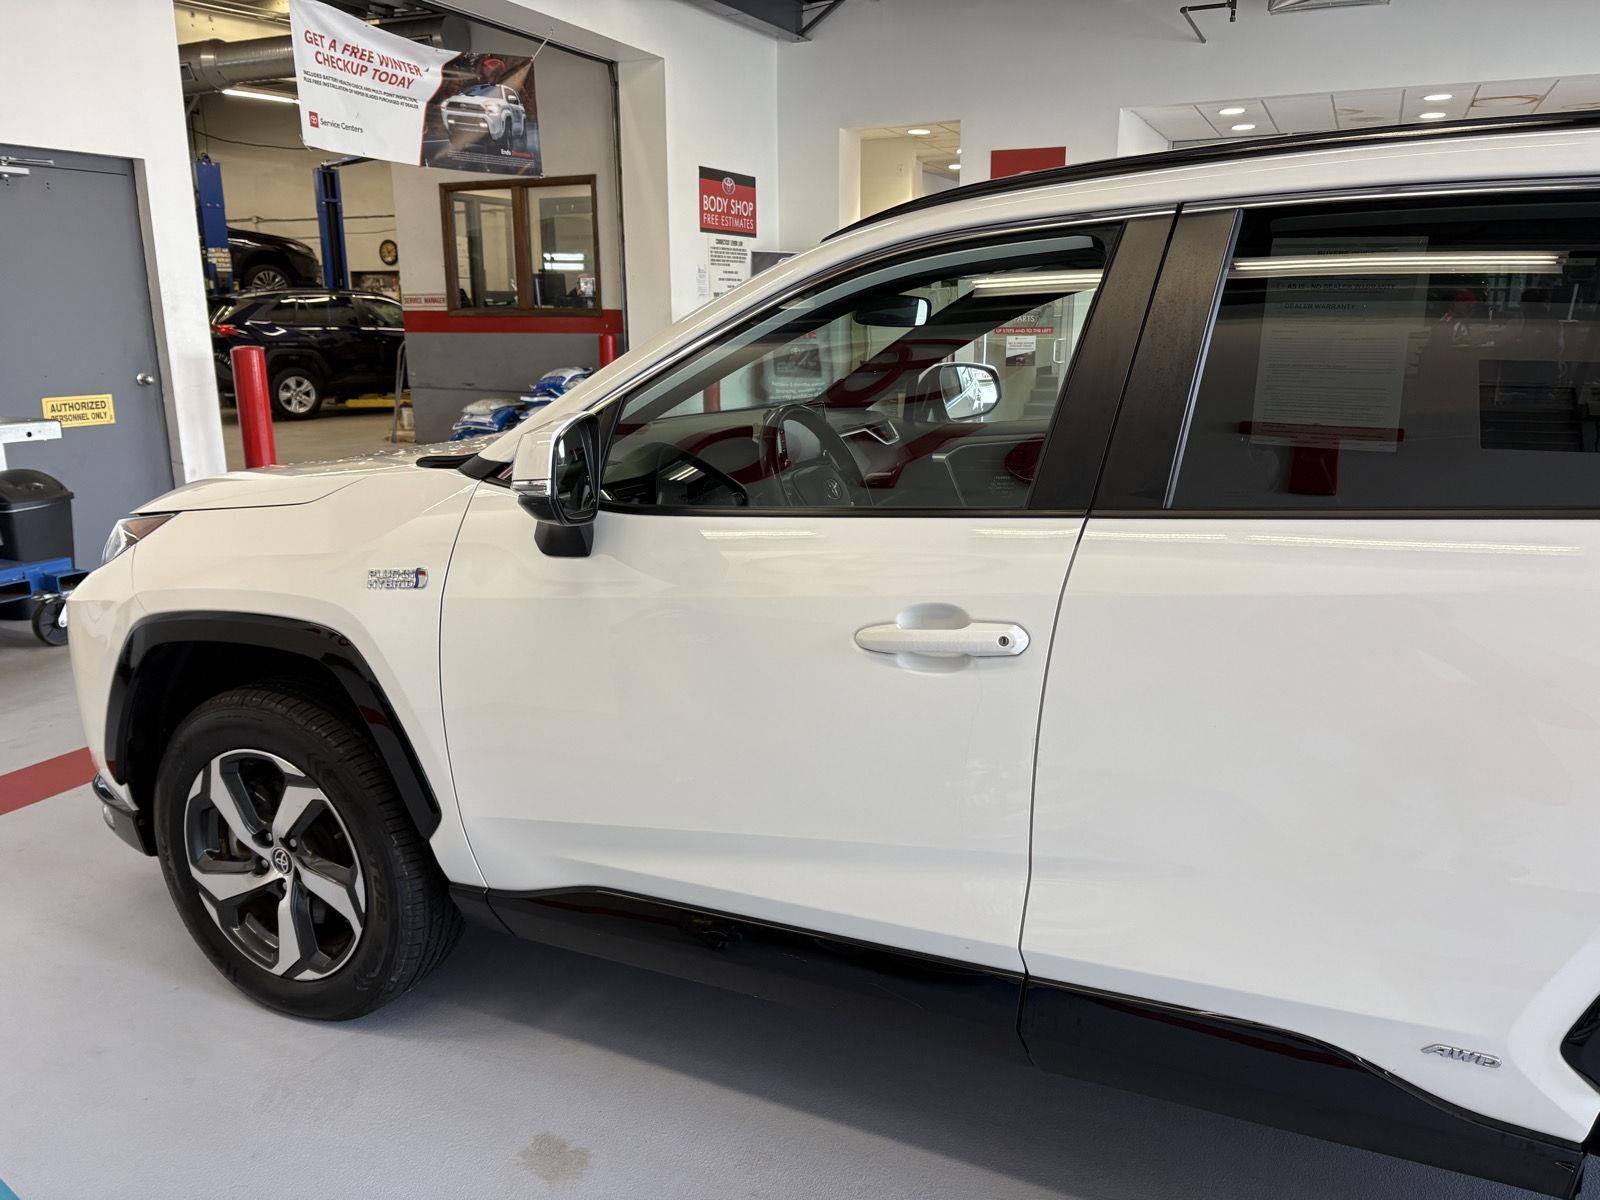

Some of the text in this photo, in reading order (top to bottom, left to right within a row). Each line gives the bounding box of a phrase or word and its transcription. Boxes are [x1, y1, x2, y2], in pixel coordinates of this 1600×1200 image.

[304, 30, 423, 77] GET A FREE WINTER
[315, 51, 414, 89] CHECKUP TODAY
[320, 118, 363, 133] Service Centers
[703, 194, 754, 217] BODY SHOP
[703, 213, 753, 230] FREE ESTIMATES
[403, 297, 445, 305] SERVICE MANAGER
[50, 400, 107, 413] AUTHORIZED
[91, 411, 107, 420] ONLY
[367, 579, 416, 590] HYBRID
[1421, 1043, 1502, 1068] AWD
